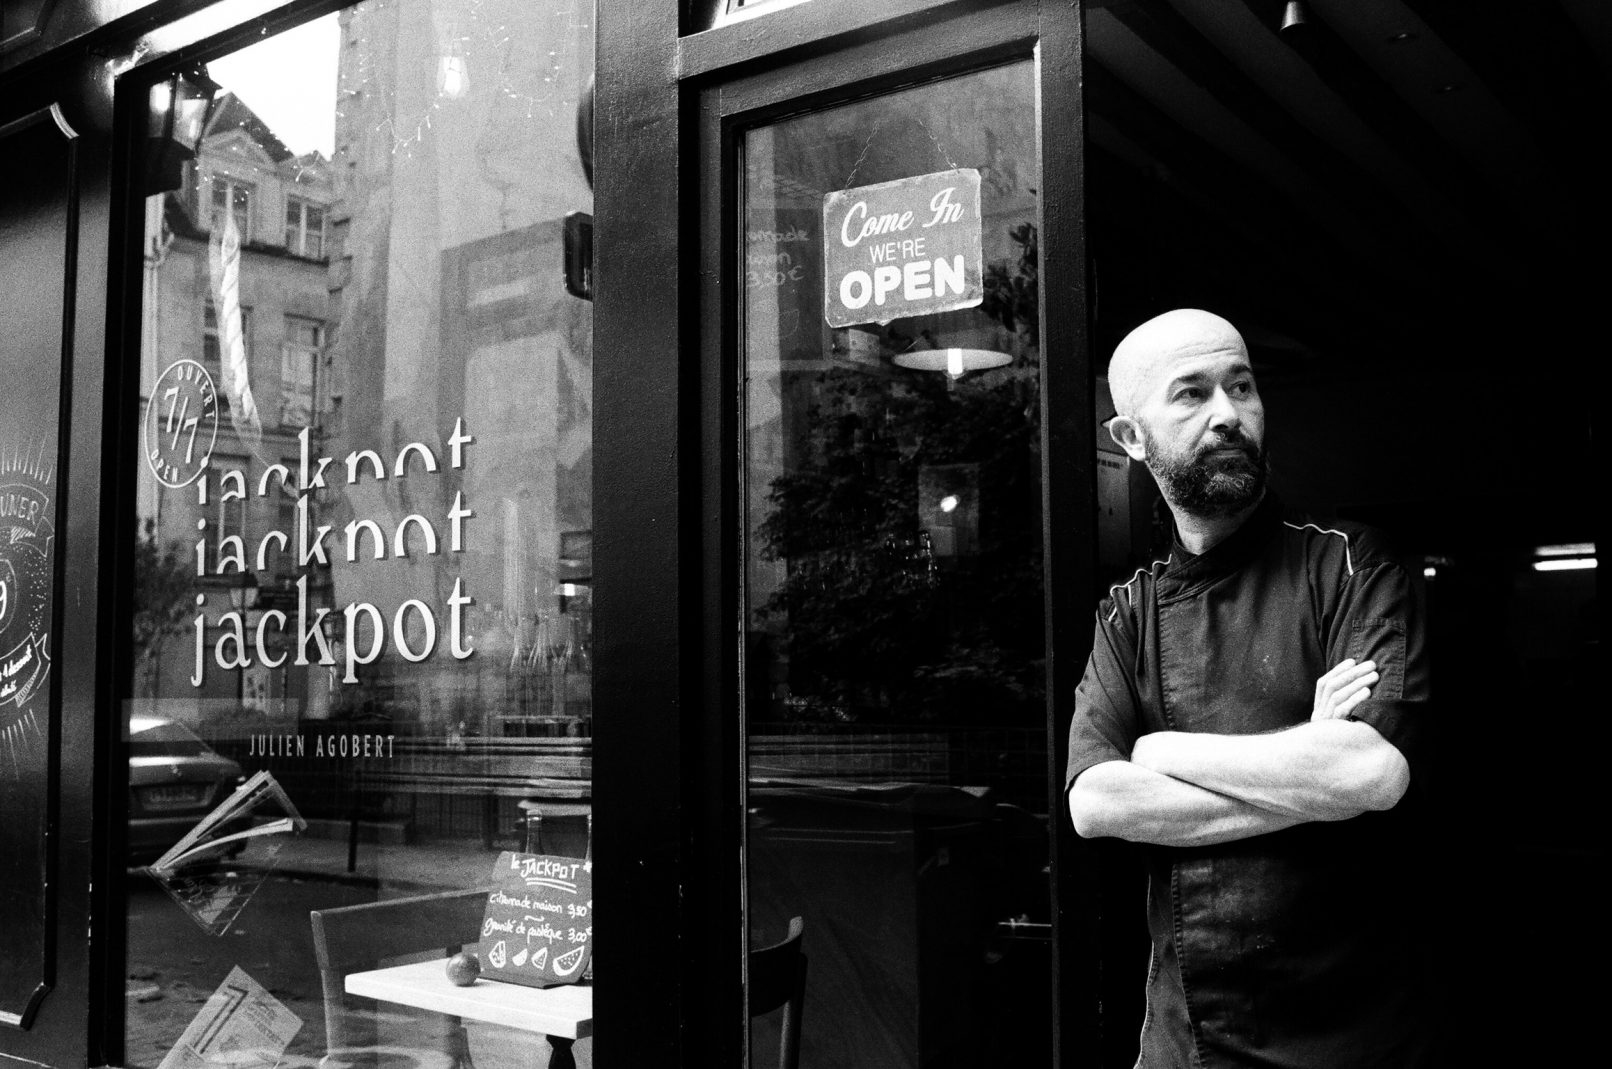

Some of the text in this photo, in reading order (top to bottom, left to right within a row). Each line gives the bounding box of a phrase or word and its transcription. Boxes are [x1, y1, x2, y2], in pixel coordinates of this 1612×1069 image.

[840, 186, 964, 248] Come In
[868, 237, 926, 264] WE'RE
[839, 254, 965, 310] OPEN
[177, 364, 216, 418] OUVERT
[163, 386, 198, 465] 7/7
[150, 448, 179, 483] OPEN
[190, 576, 474, 687] jackpot
[249, 733, 395, 758] JULIEN AGOBERT
[520, 858, 580, 880] JACKPOT
[533, 900, 563, 914] maison
[516, 921, 526, 934] de
